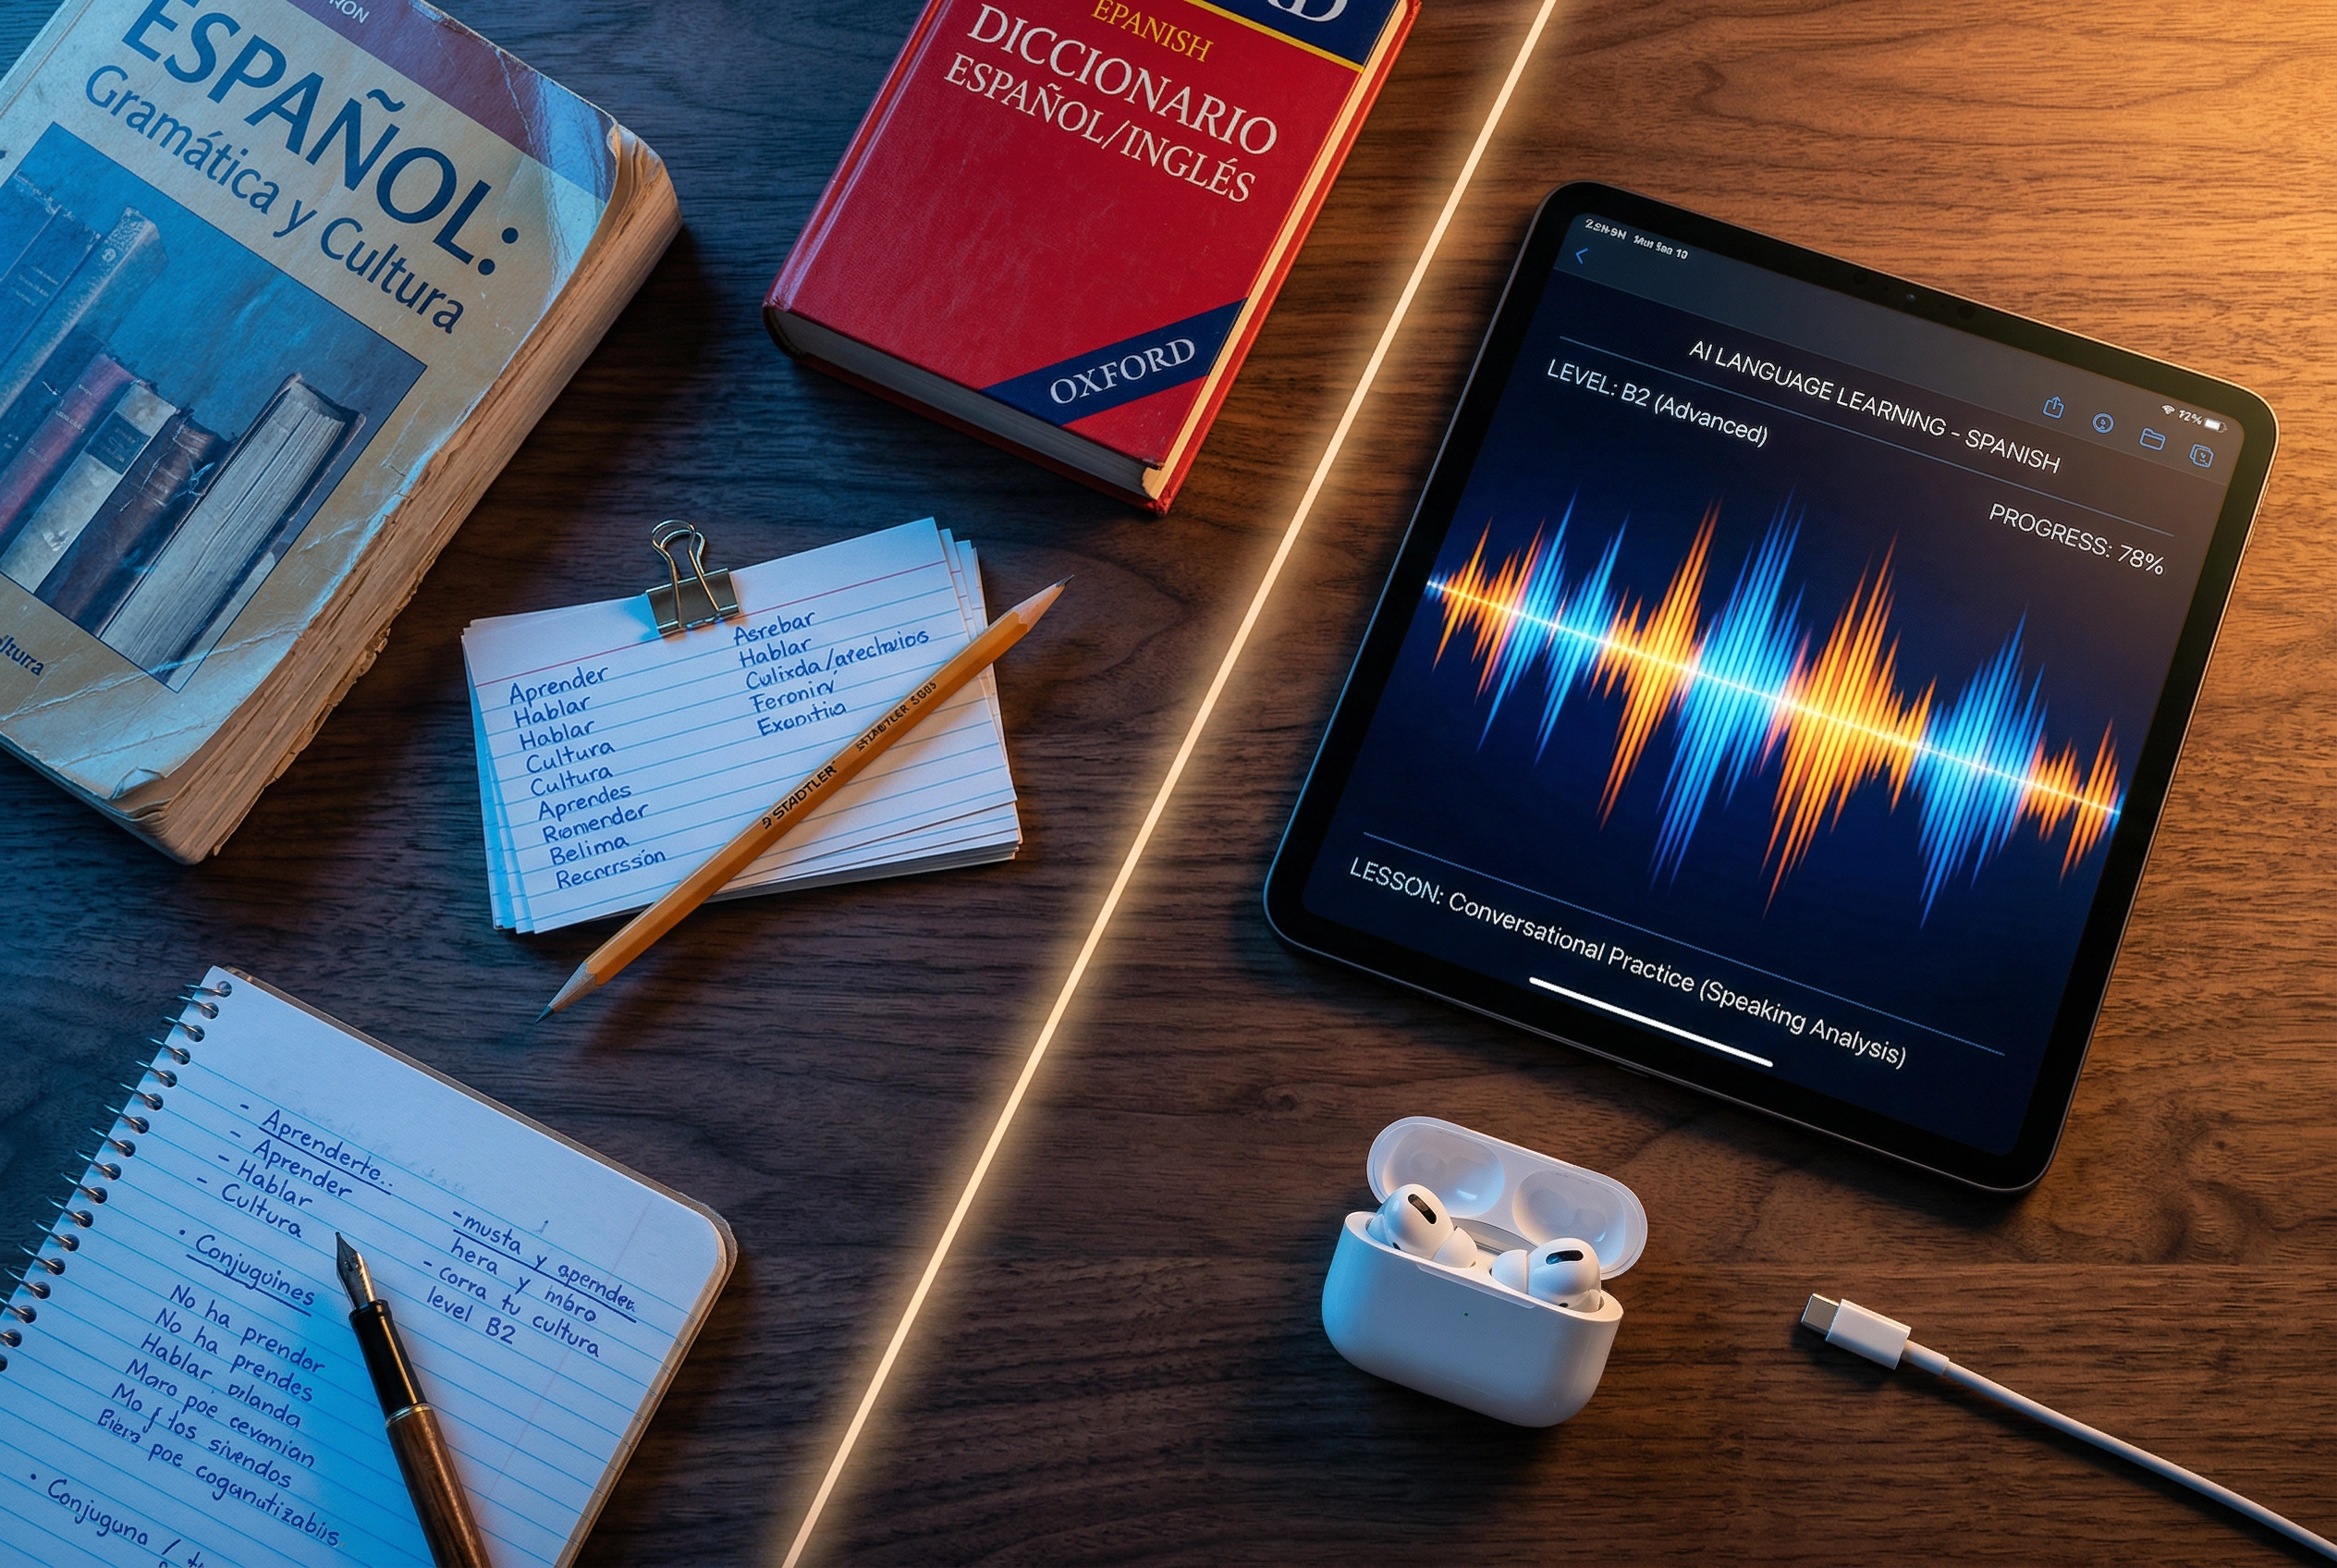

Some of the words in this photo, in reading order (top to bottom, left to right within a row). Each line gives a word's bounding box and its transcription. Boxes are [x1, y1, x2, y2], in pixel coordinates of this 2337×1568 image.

[1092, 0, 1214, 63] EPANISH
[967, 3, 1279, 155] DICCIONARIO
[121, 0, 520, 276] ESPAÑOL:
[944, 52, 1256, 202] ESPAÑOL/INGLÉS
[86, 65, 280, 215] Gramática
[272, 199, 318, 239] y
[320, 216, 465, 335] Cultura
[1050, 338, 1196, 404] OXFORD
[1547, 359, 1619, 397] LEVEL:
[1621, 382, 1651, 407] B2
[1654, 393, 1768, 448] (Advanced)
[1688, 339, 1713, 361] AI
[1714, 347, 1835, 401] LANGUAGE
[1836, 386, 1948, 437] LEARNING
[1964, 428, 2062, 474] SPANISH
[1988, 502, 2113, 558] PROGRESS:
[2117, 544, 2165, 575] 78%
[740, 637, 812, 668] Hablar
[509, 666, 609, 708] Aprender
[514, 696, 591, 729] Hablar
[519, 720, 595, 751] Hablar
[525, 741, 617, 774] Cultura
[530, 766, 614, 797] Cultura
[538, 784, 632, 823] Aprendes
[549, 835, 630, 865] Belima
[1349, 856, 1445, 905] LESSON:
[1449, 891, 1606, 962] Conversational
[1608, 945, 1695, 993] Practice
[1699, 978, 1807, 1036] (Speaking
[1809, 1018, 1907, 1071] Analysis)
[236, 1158, 313, 1208] Hablar
[251, 1138, 353, 1199] Aprender
[221, 1182, 302, 1239] Cultura
[450, 1236, 498, 1276] hera
[514, 1276, 531, 1295] y
[168, 1284, 196, 1309] No
[204, 1299, 231, 1329] ha
[425, 1285, 474, 1323] level
[484, 1316, 517, 1345] B2
[140, 1332, 214, 1381] Hablar
[154, 1307, 182, 1334] No
[192, 1325, 219, 1355] ha
[229, 1353, 313, 1403] prendes
[532, 1314, 600, 1358] cultura
[111, 1382, 143, 1412] Mo
[180, 1394, 219, 1419] poe
[147, 1442, 184, 1468] poe
